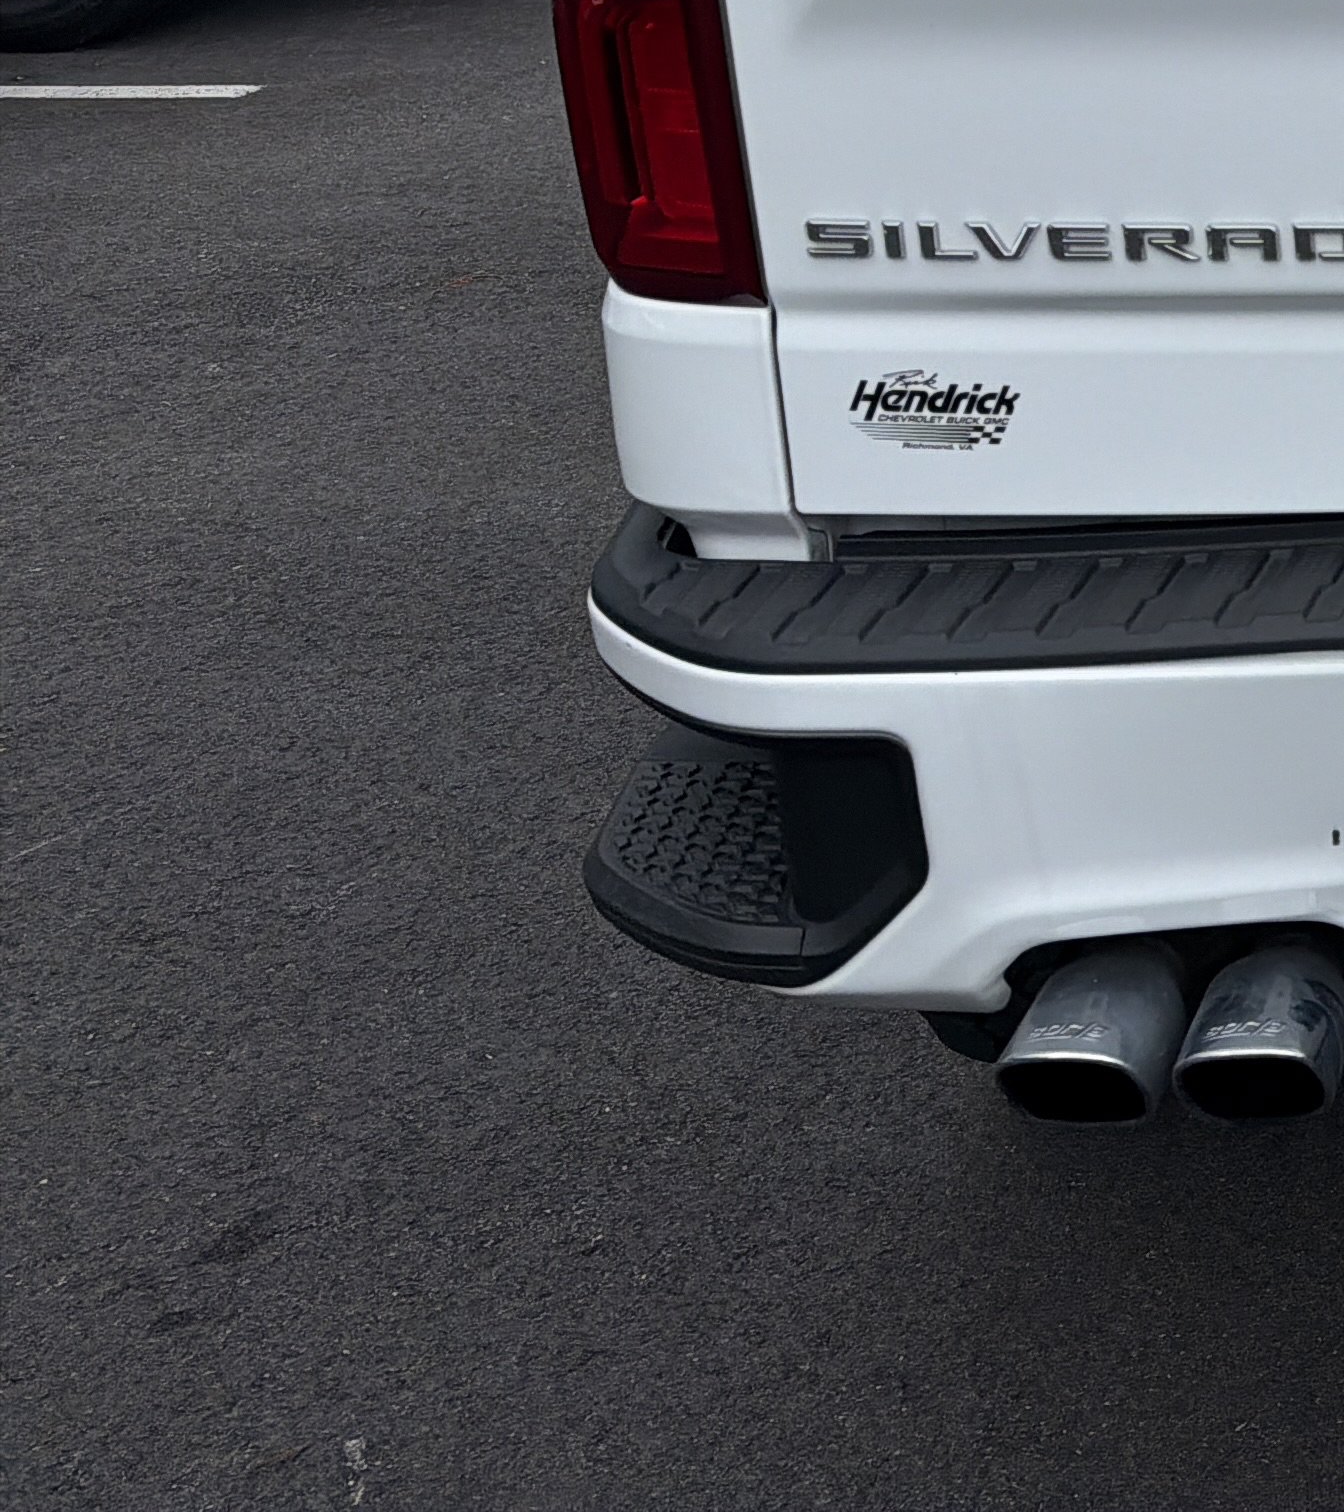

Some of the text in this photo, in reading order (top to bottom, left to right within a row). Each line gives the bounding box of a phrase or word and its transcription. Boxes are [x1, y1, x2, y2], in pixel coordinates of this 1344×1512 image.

[849, 379, 1021, 422] Hendrick
[877, 413, 1010, 426] CHEVROLET BUICK GMC
